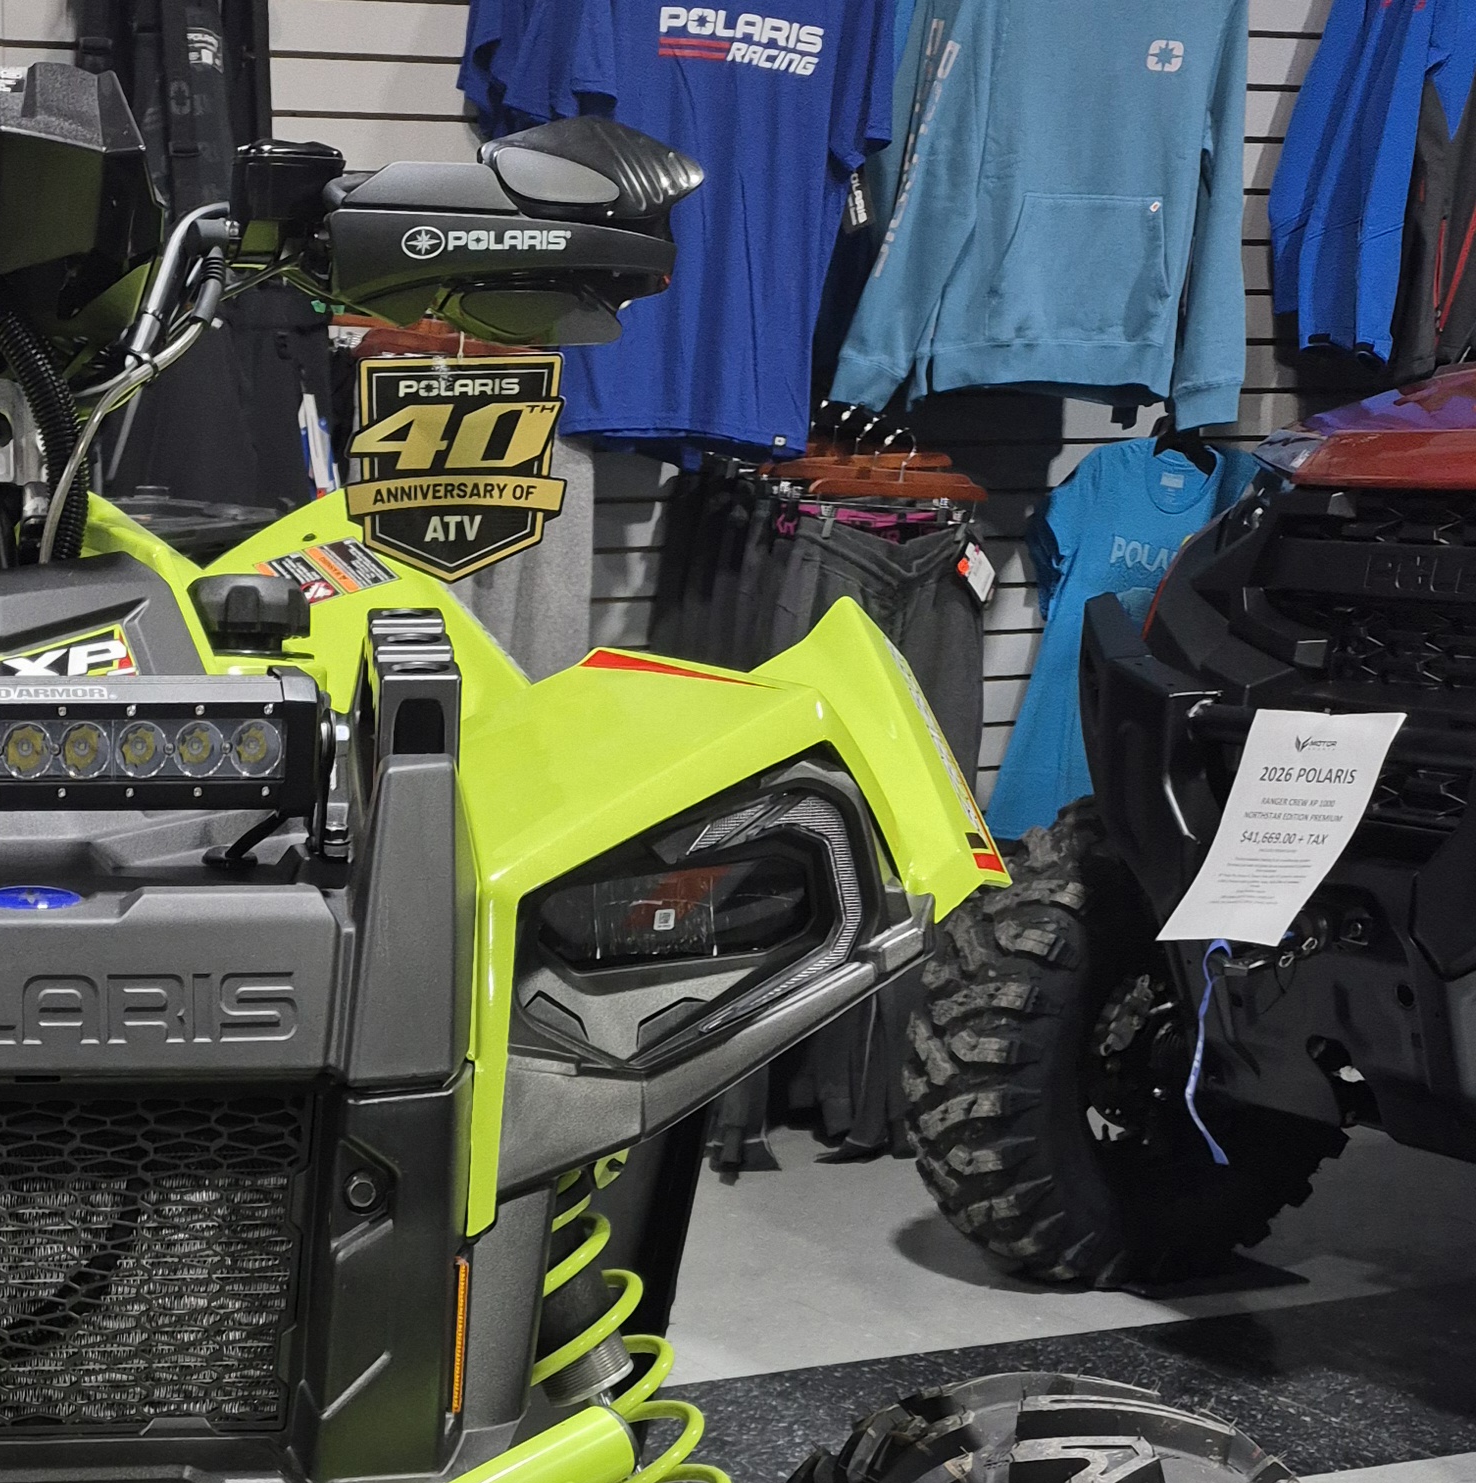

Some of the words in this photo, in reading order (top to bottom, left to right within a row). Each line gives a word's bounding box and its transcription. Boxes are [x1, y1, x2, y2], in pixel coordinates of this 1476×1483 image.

[659, 6, 824, 53] POLARIS
[726, 41, 819, 76] RACING
[447, 230, 567, 251] POLARIS
[398, 378, 520, 398] POLARIS
[372, 483, 508, 505] ANNIVERSARY
[512, 485, 538, 501] OF
[424, 514, 483, 542] ATV
[3, 640, 128, 676] XP
[17, 687, 105, 698] ARMOR
[1259, 766, 1294, 782] 2026
[1295, 768, 1357, 784] POLARIS
[1261, 797, 1287, 806] RANGER
[1288, 798, 1308, 807] CREW
[1319, 800, 1335, 808] 1000
[1244, 811, 1281, 820] NORTHSTAR
[1282, 813, 1308, 821] EDITION
[1309, 814, 1343, 822] PREMIUM
[1240, 830, 1297, 845] $41,669.00
[1306, 834, 1328, 845] TAX
